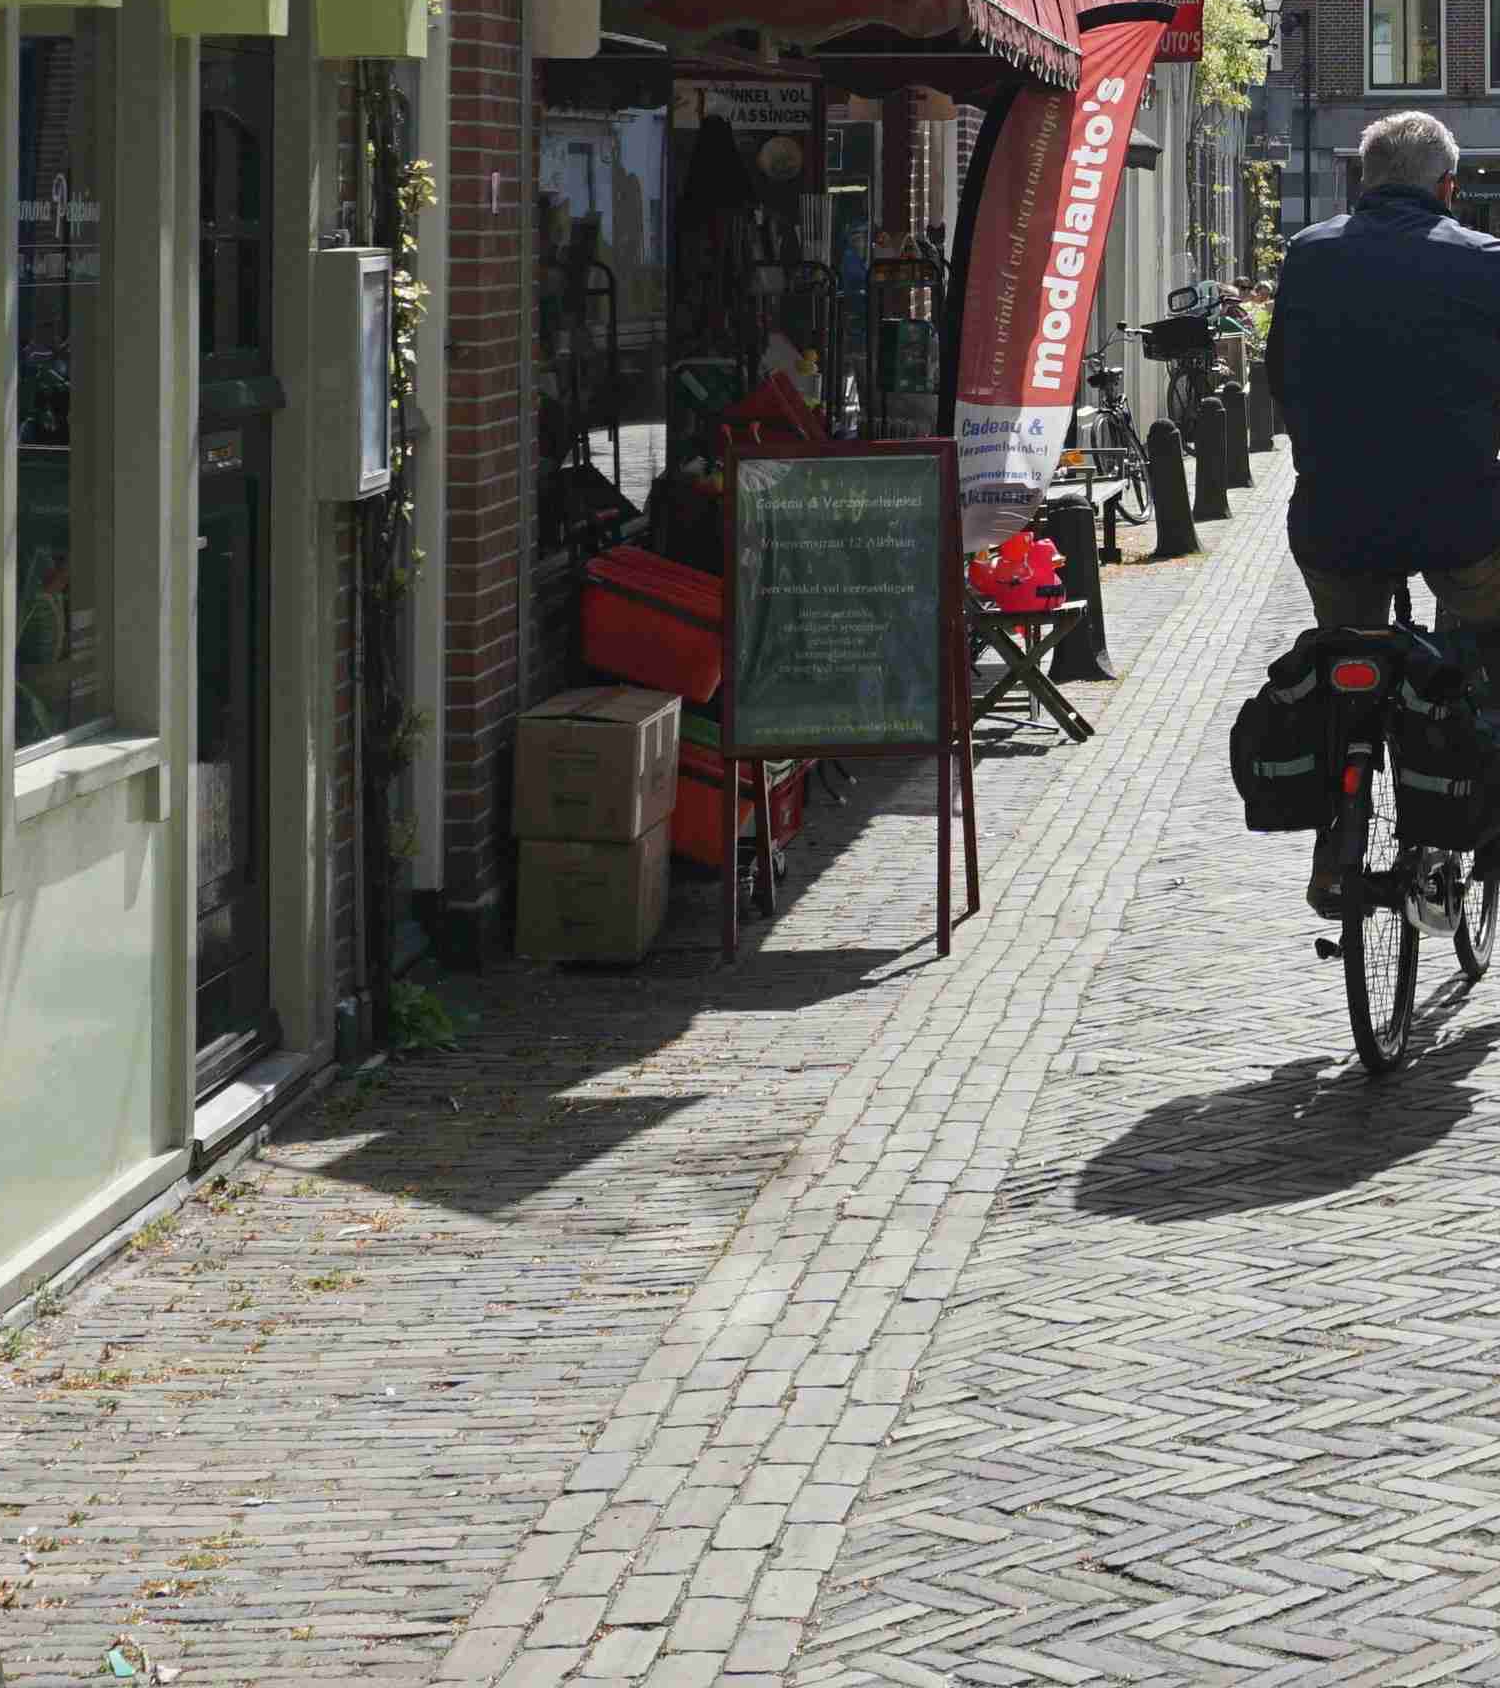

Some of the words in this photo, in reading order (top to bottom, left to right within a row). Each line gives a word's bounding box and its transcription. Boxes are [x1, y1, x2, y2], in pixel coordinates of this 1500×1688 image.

[1159, 31, 1201, 54] UTO'S
[1032, 77, 1125, 390] modelauto's
[962, 416, 1022, 437] Cadeau
[1027, 418, 1045, 435] &
